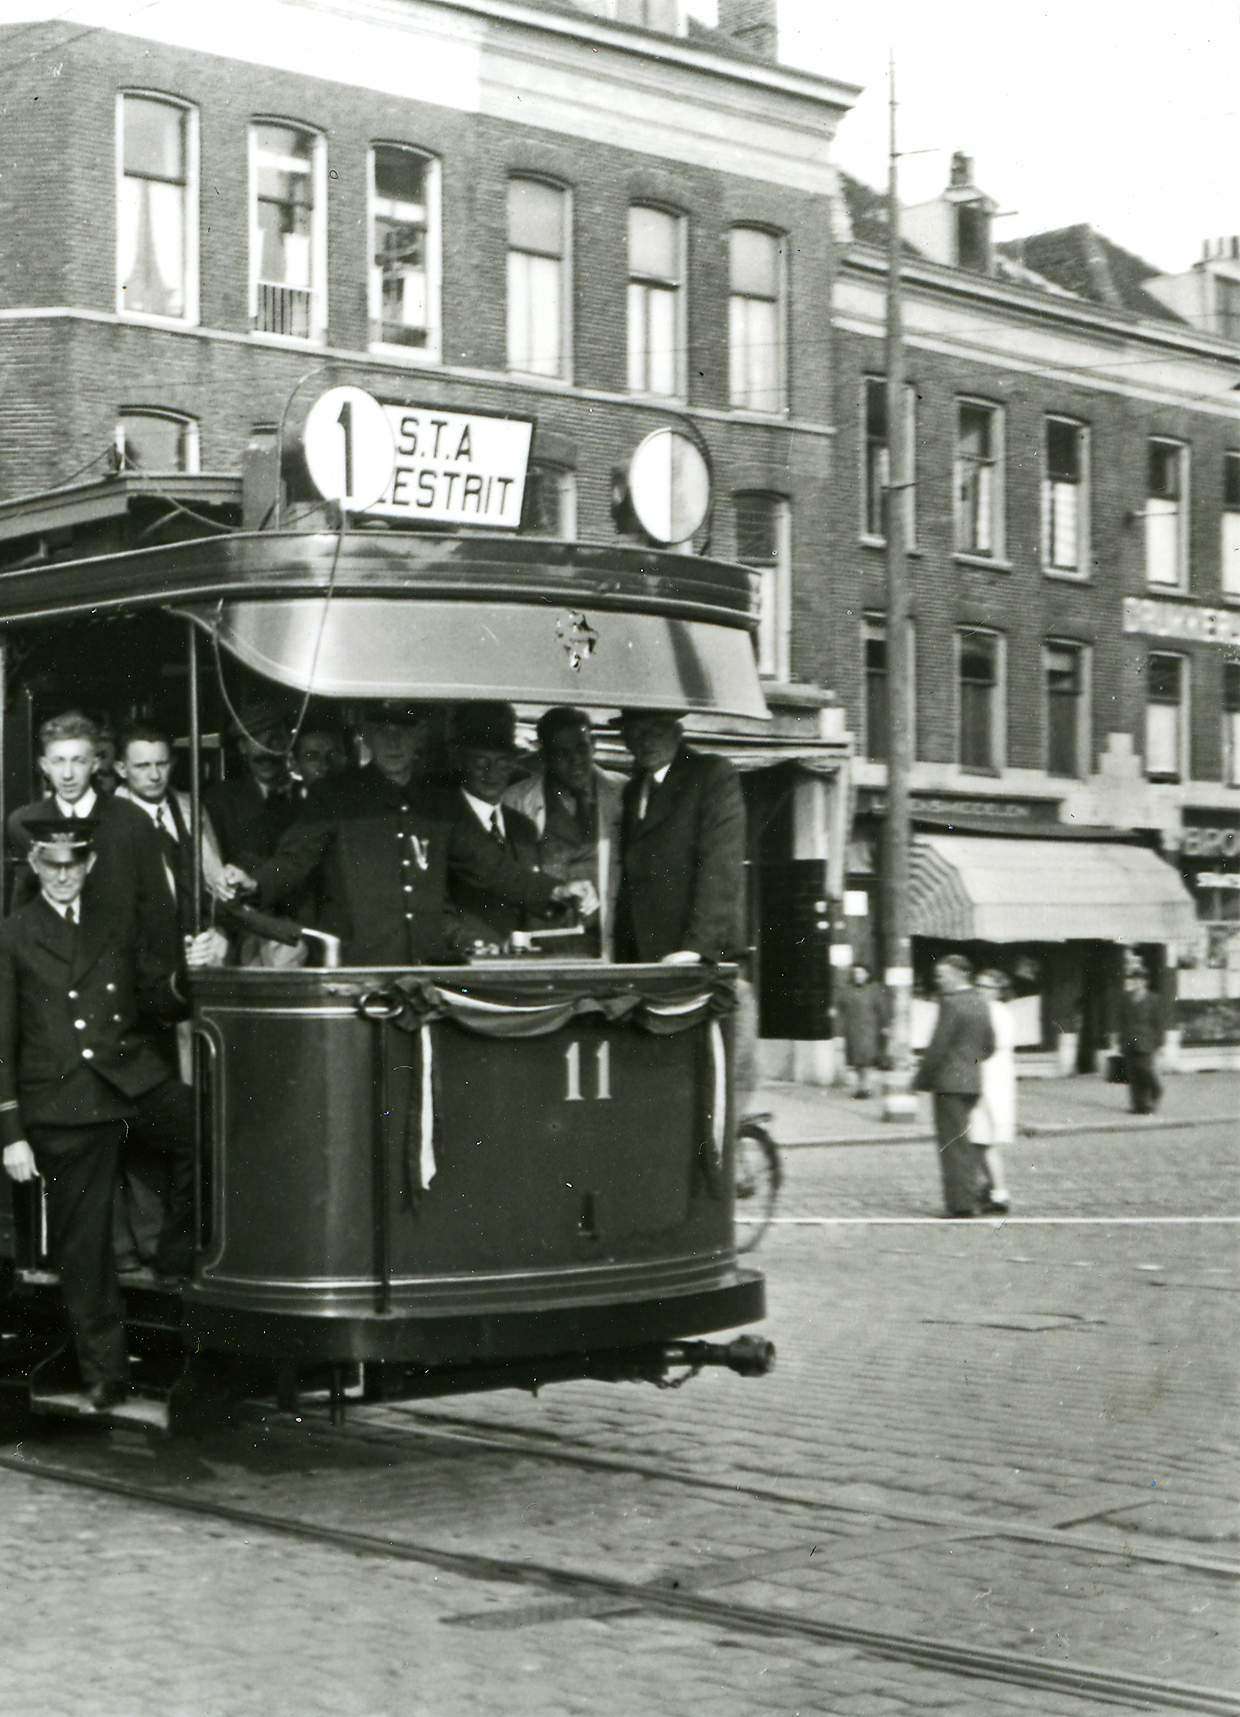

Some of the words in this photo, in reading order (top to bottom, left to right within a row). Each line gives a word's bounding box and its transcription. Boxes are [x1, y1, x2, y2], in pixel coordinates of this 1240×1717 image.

[336, 400, 353, 498] 1
[376, 465, 515, 516] ESTRIT
[564, 1040, 612, 1101] 11
